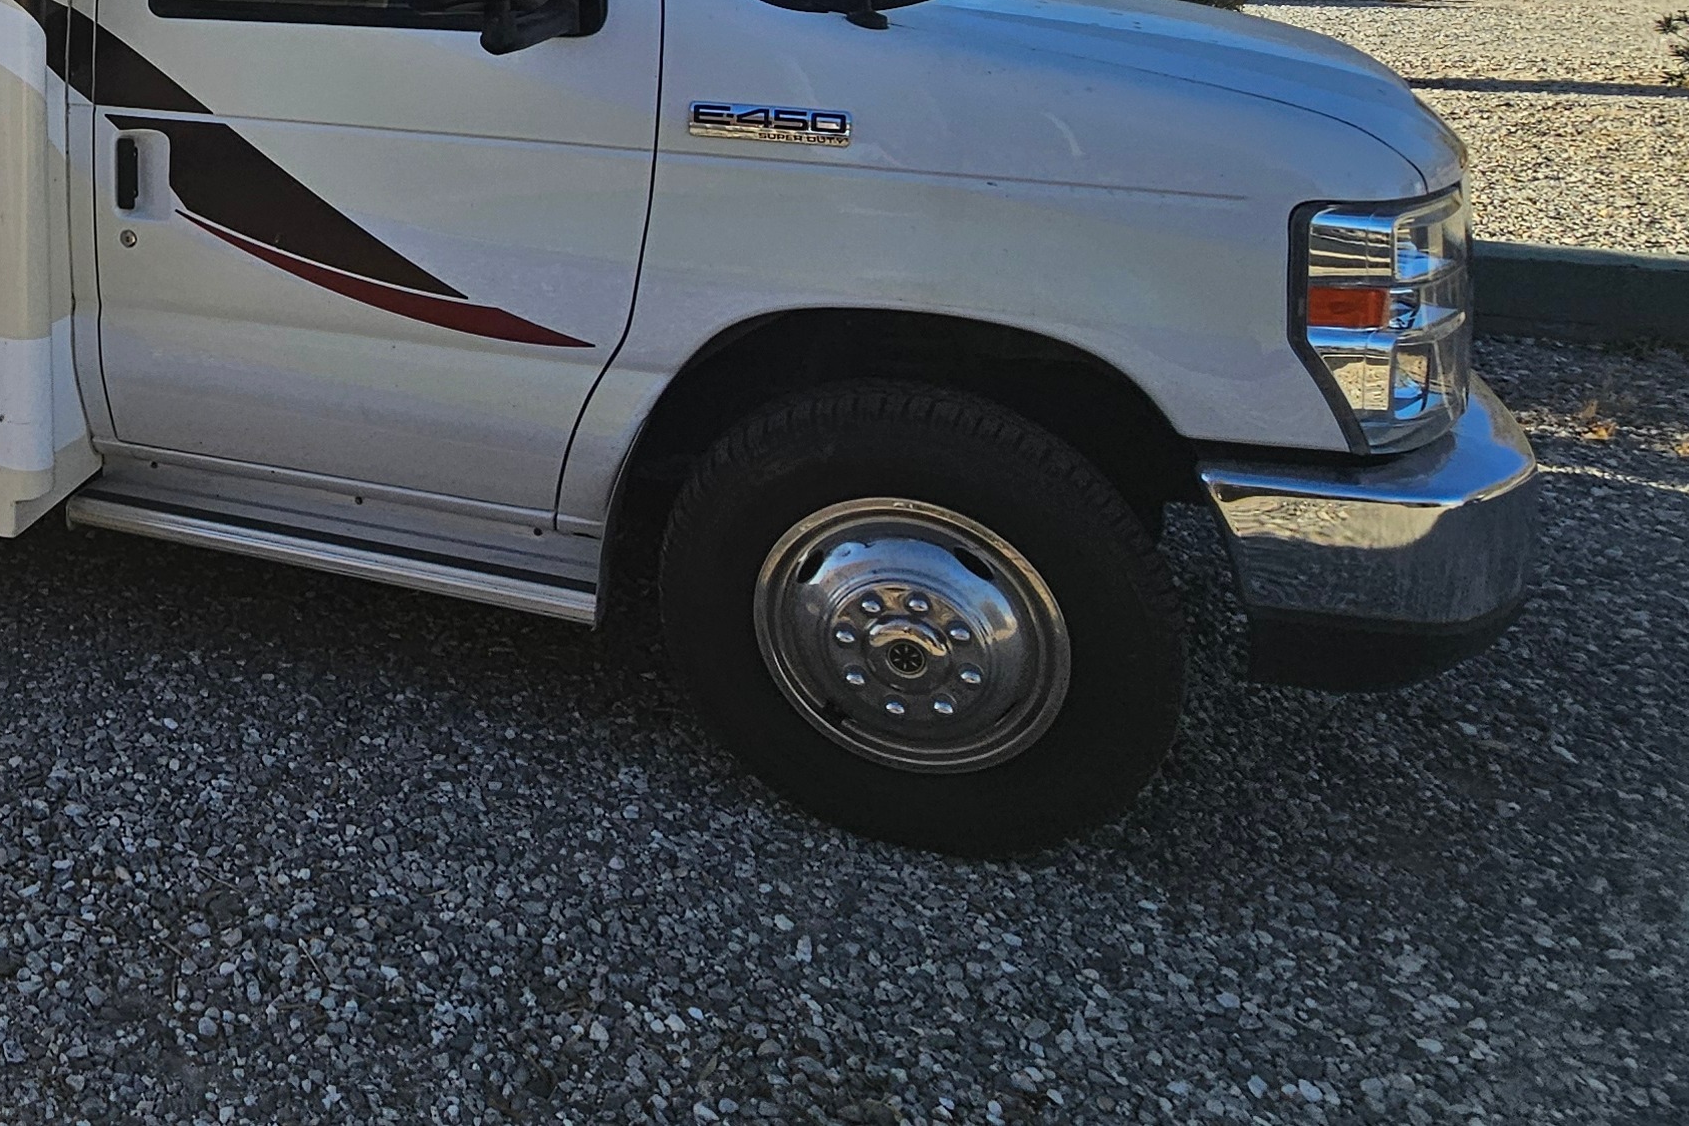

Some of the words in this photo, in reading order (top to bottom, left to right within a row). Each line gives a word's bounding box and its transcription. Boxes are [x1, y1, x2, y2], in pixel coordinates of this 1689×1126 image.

[693, 104, 847, 133] E-450
[758, 132, 803, 142] SUPER
[806, 134, 847, 145] DUTY
